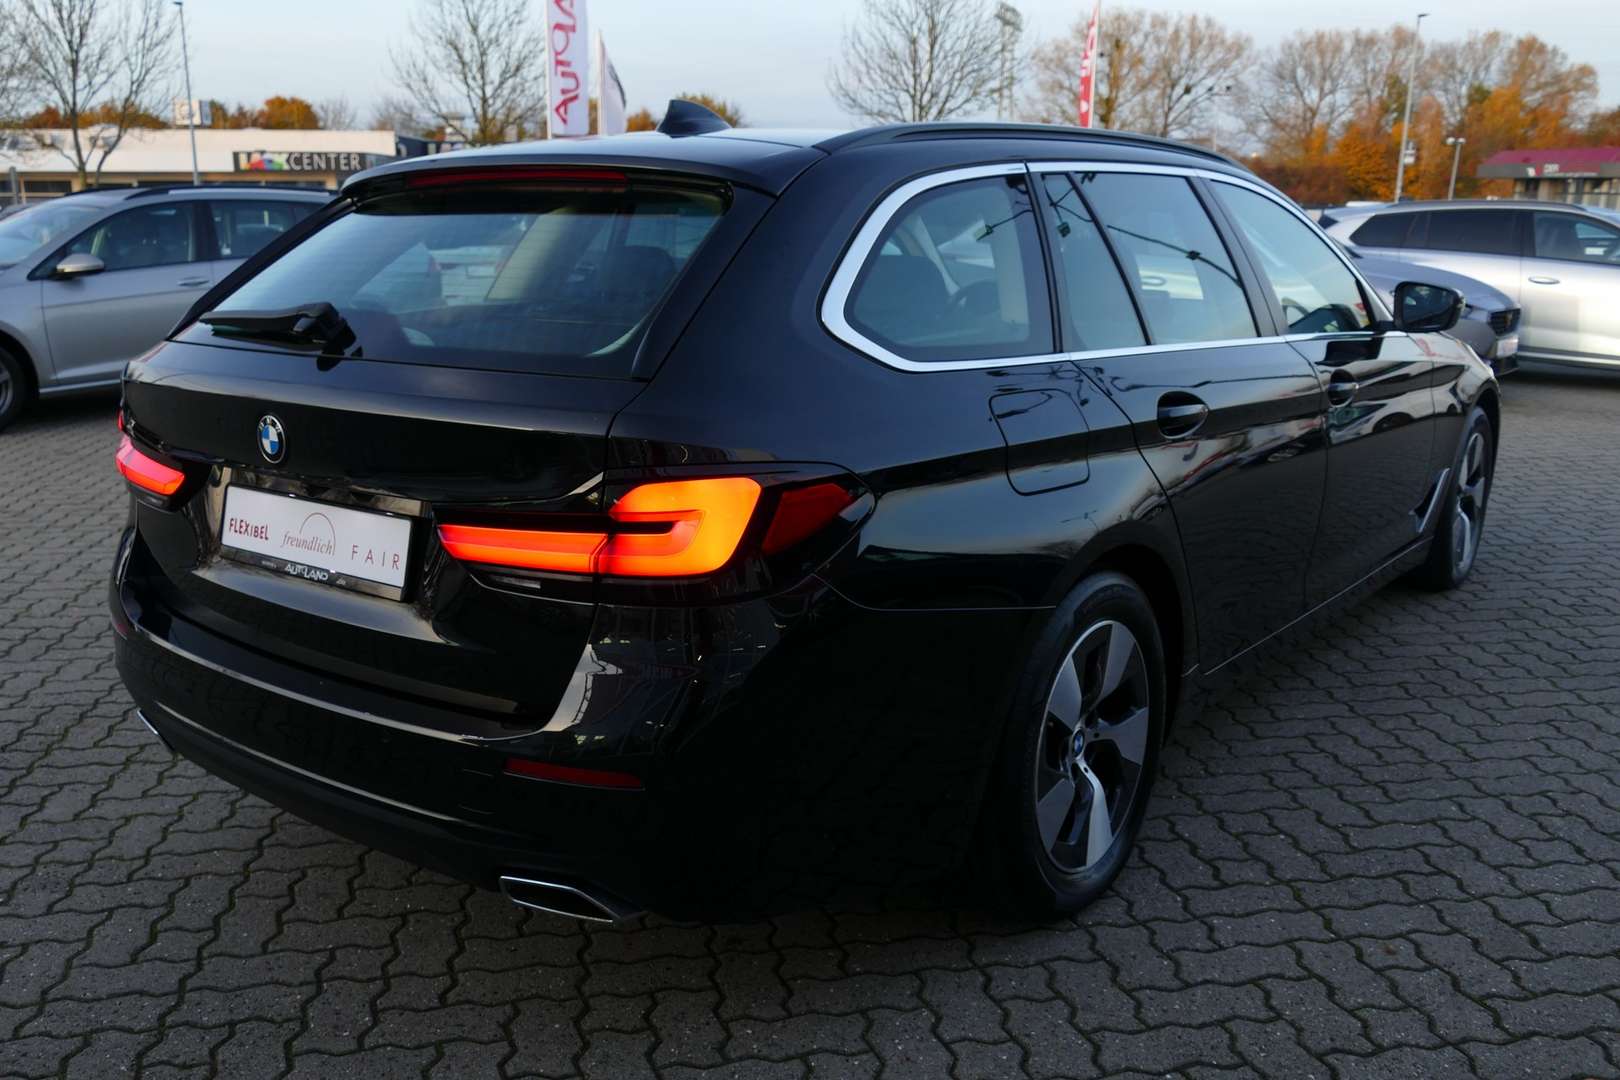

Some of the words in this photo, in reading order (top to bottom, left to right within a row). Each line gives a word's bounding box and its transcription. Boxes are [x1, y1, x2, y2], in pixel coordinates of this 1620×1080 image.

[228, 517, 270, 541] FLEXIBEL
[280, 530, 336, 556] freundlich
[351, 544, 400, 570] FAIR
[284, 563, 329, 582] AUTOLAND
